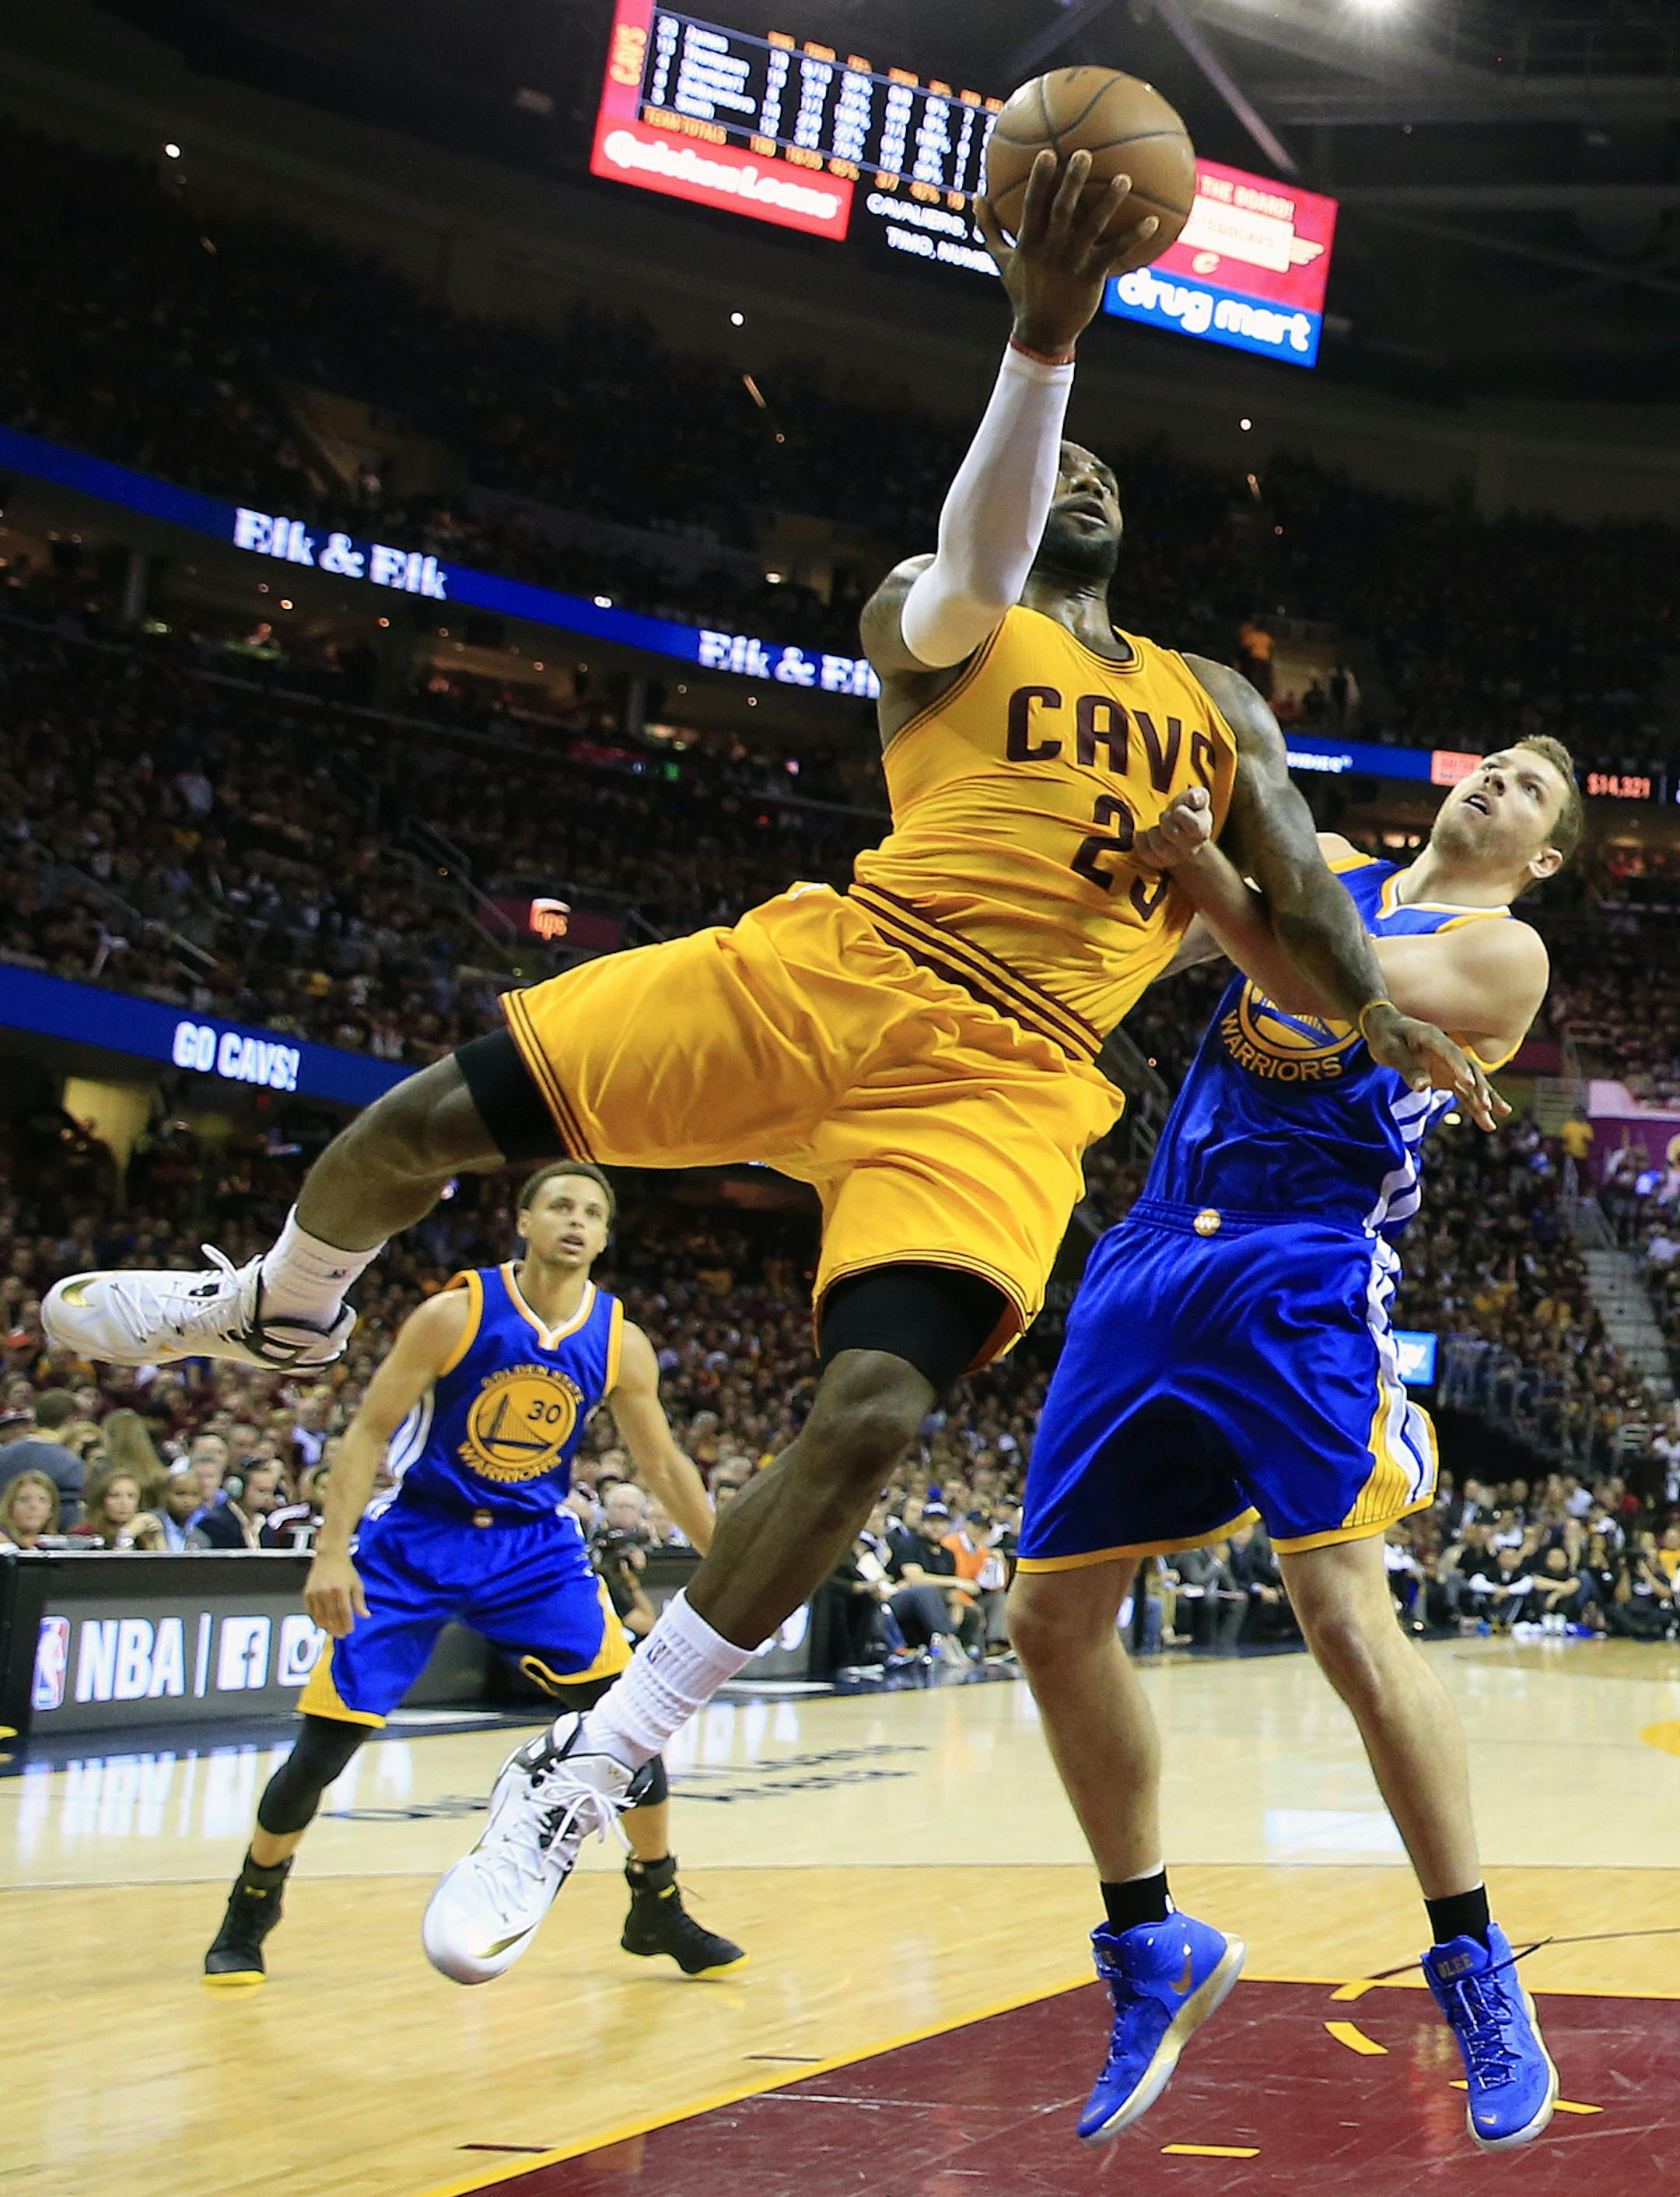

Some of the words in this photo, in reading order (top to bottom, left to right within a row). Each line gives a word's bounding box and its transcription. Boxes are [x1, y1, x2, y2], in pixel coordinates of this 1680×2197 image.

[1118, 268, 1214, 334] drug
[1215, 295, 1311, 352] mart
[319, 532, 364, 578] &
[775, 646, 816, 687] &
[173, 1021, 217, 1072] GO
[217, 1032, 300, 1091] CAVS!
[1220, 1008, 1343, 1083] WARRIORS
[527, 1400, 562, 1424] 30
[75, 1617, 184, 1703] NBA
